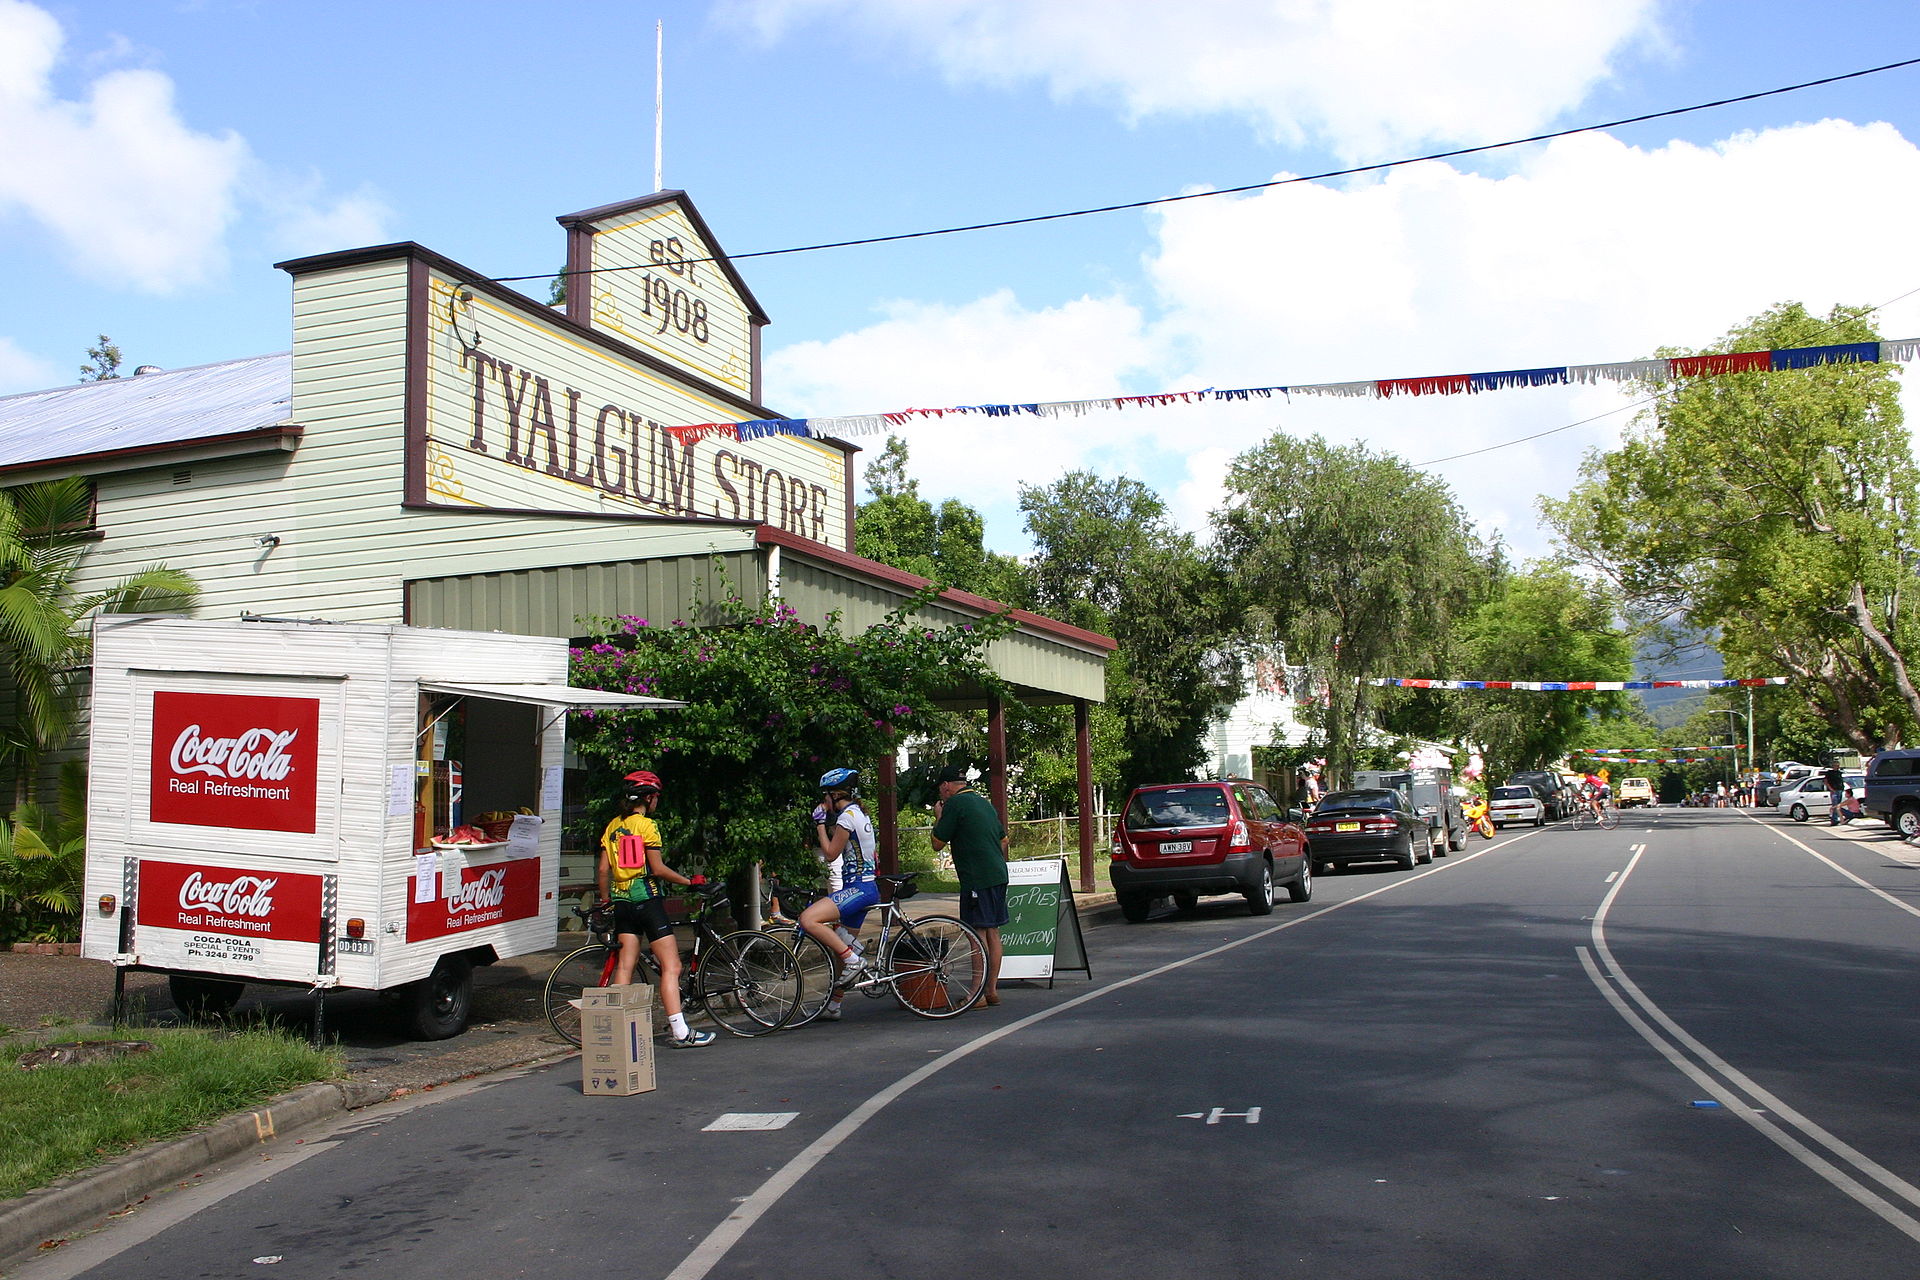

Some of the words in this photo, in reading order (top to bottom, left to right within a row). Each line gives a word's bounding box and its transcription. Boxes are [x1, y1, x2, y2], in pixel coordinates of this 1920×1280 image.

[640, 273, 710, 344] 1908
[462, 348, 698, 519] TYALGUM
[714, 449, 829, 546] STORE
[169, 724, 299, 782] Coca-Cola
[169, 778, 199, 795] Real
[204, 780, 290, 801] Refreshment
[179, 871, 278, 917] Coca-Cola
[1006, 888, 1028, 908] OT
[1028, 886, 1058, 907] PIES
[178, 912, 202, 926] Real
[205, 914, 271, 932] Refreshment
[446, 916, 463, 928] Real
[464, 908, 503, 925] Refreshment
[183, 941, 222, 951] SPECIAL
[226, 945, 261, 954] EVENTS
[193, 935, 252, 947] COCA-COLA
[1000, 927, 1056, 948] AMINGTONS
[188, 949, 203, 957] Ph.
[205, 951, 228, 959] 3248
[232, 953, 254, 961] 2799
